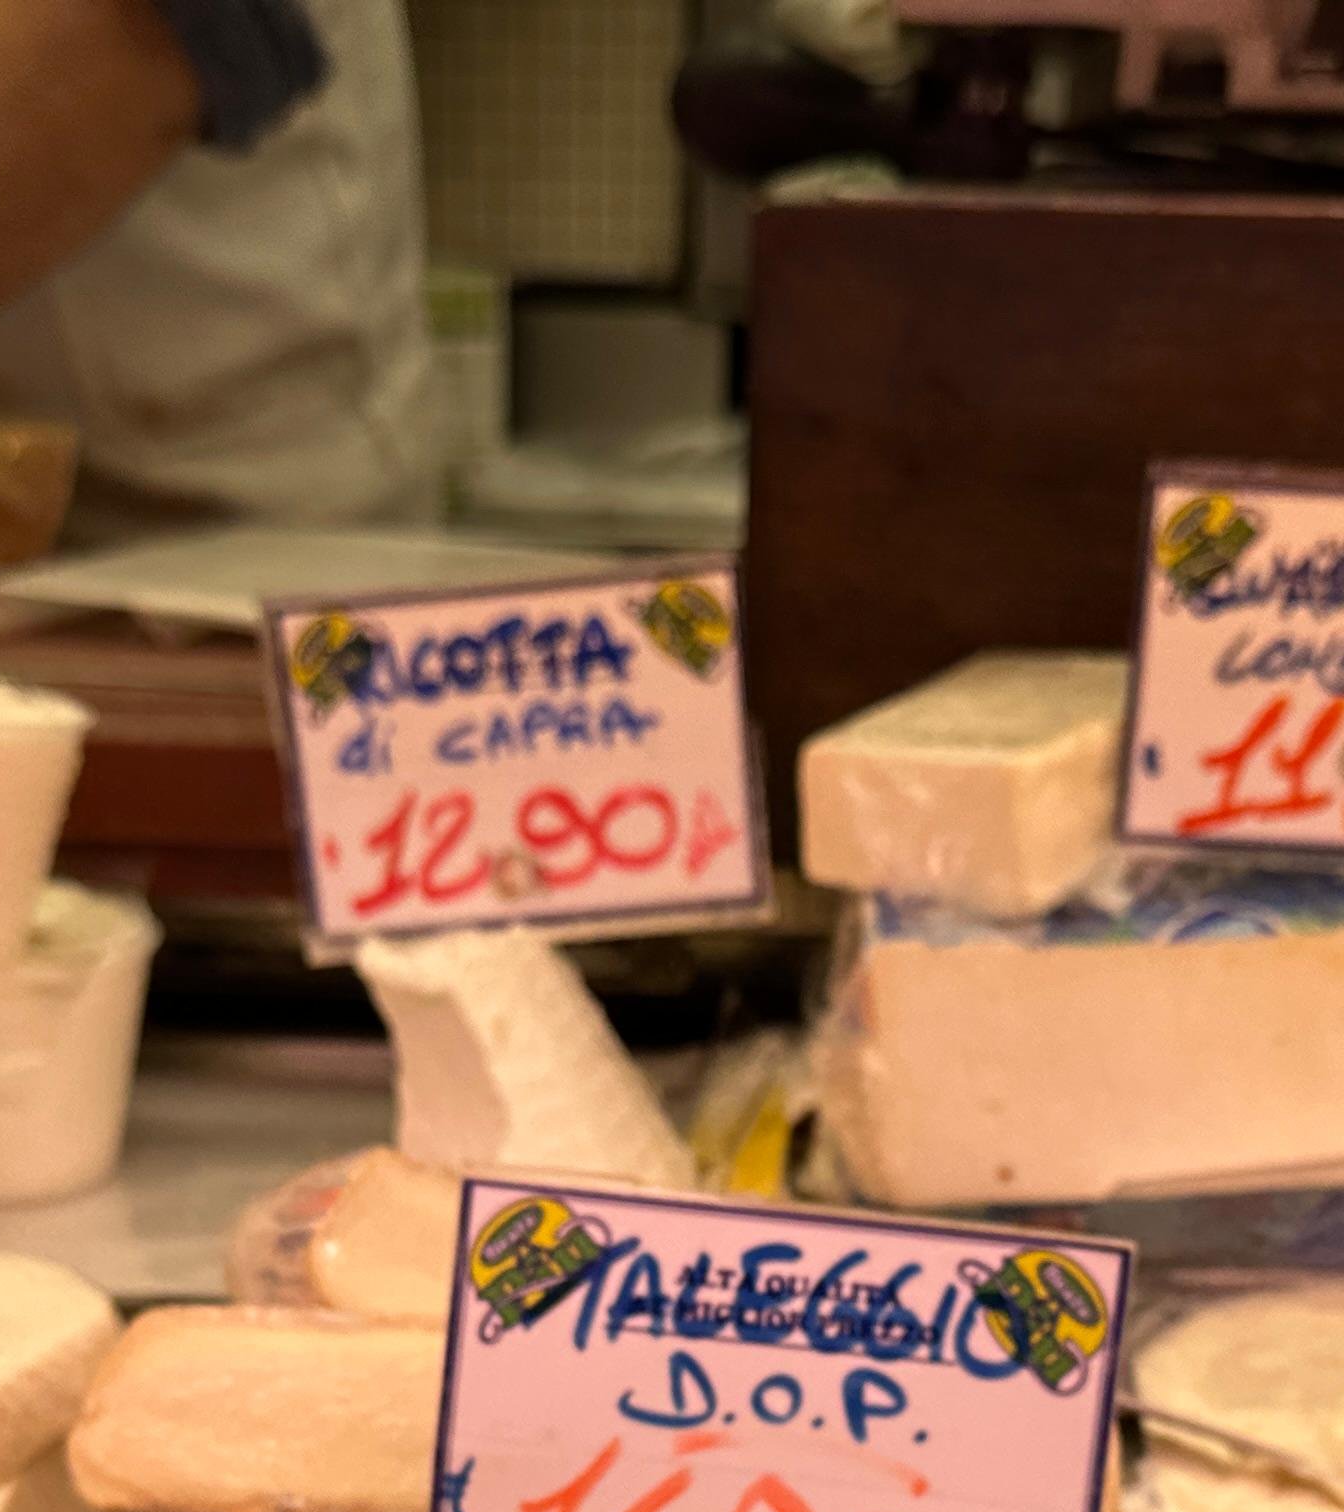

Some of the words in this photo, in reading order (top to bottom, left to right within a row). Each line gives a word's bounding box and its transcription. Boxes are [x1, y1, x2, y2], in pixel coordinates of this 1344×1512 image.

[338, 716, 396, 774] di
[435, 699, 660, 766] CAPRA
[351, 784, 681, 915] 1290
[618, 1350, 929, 1445] D.O.P.
